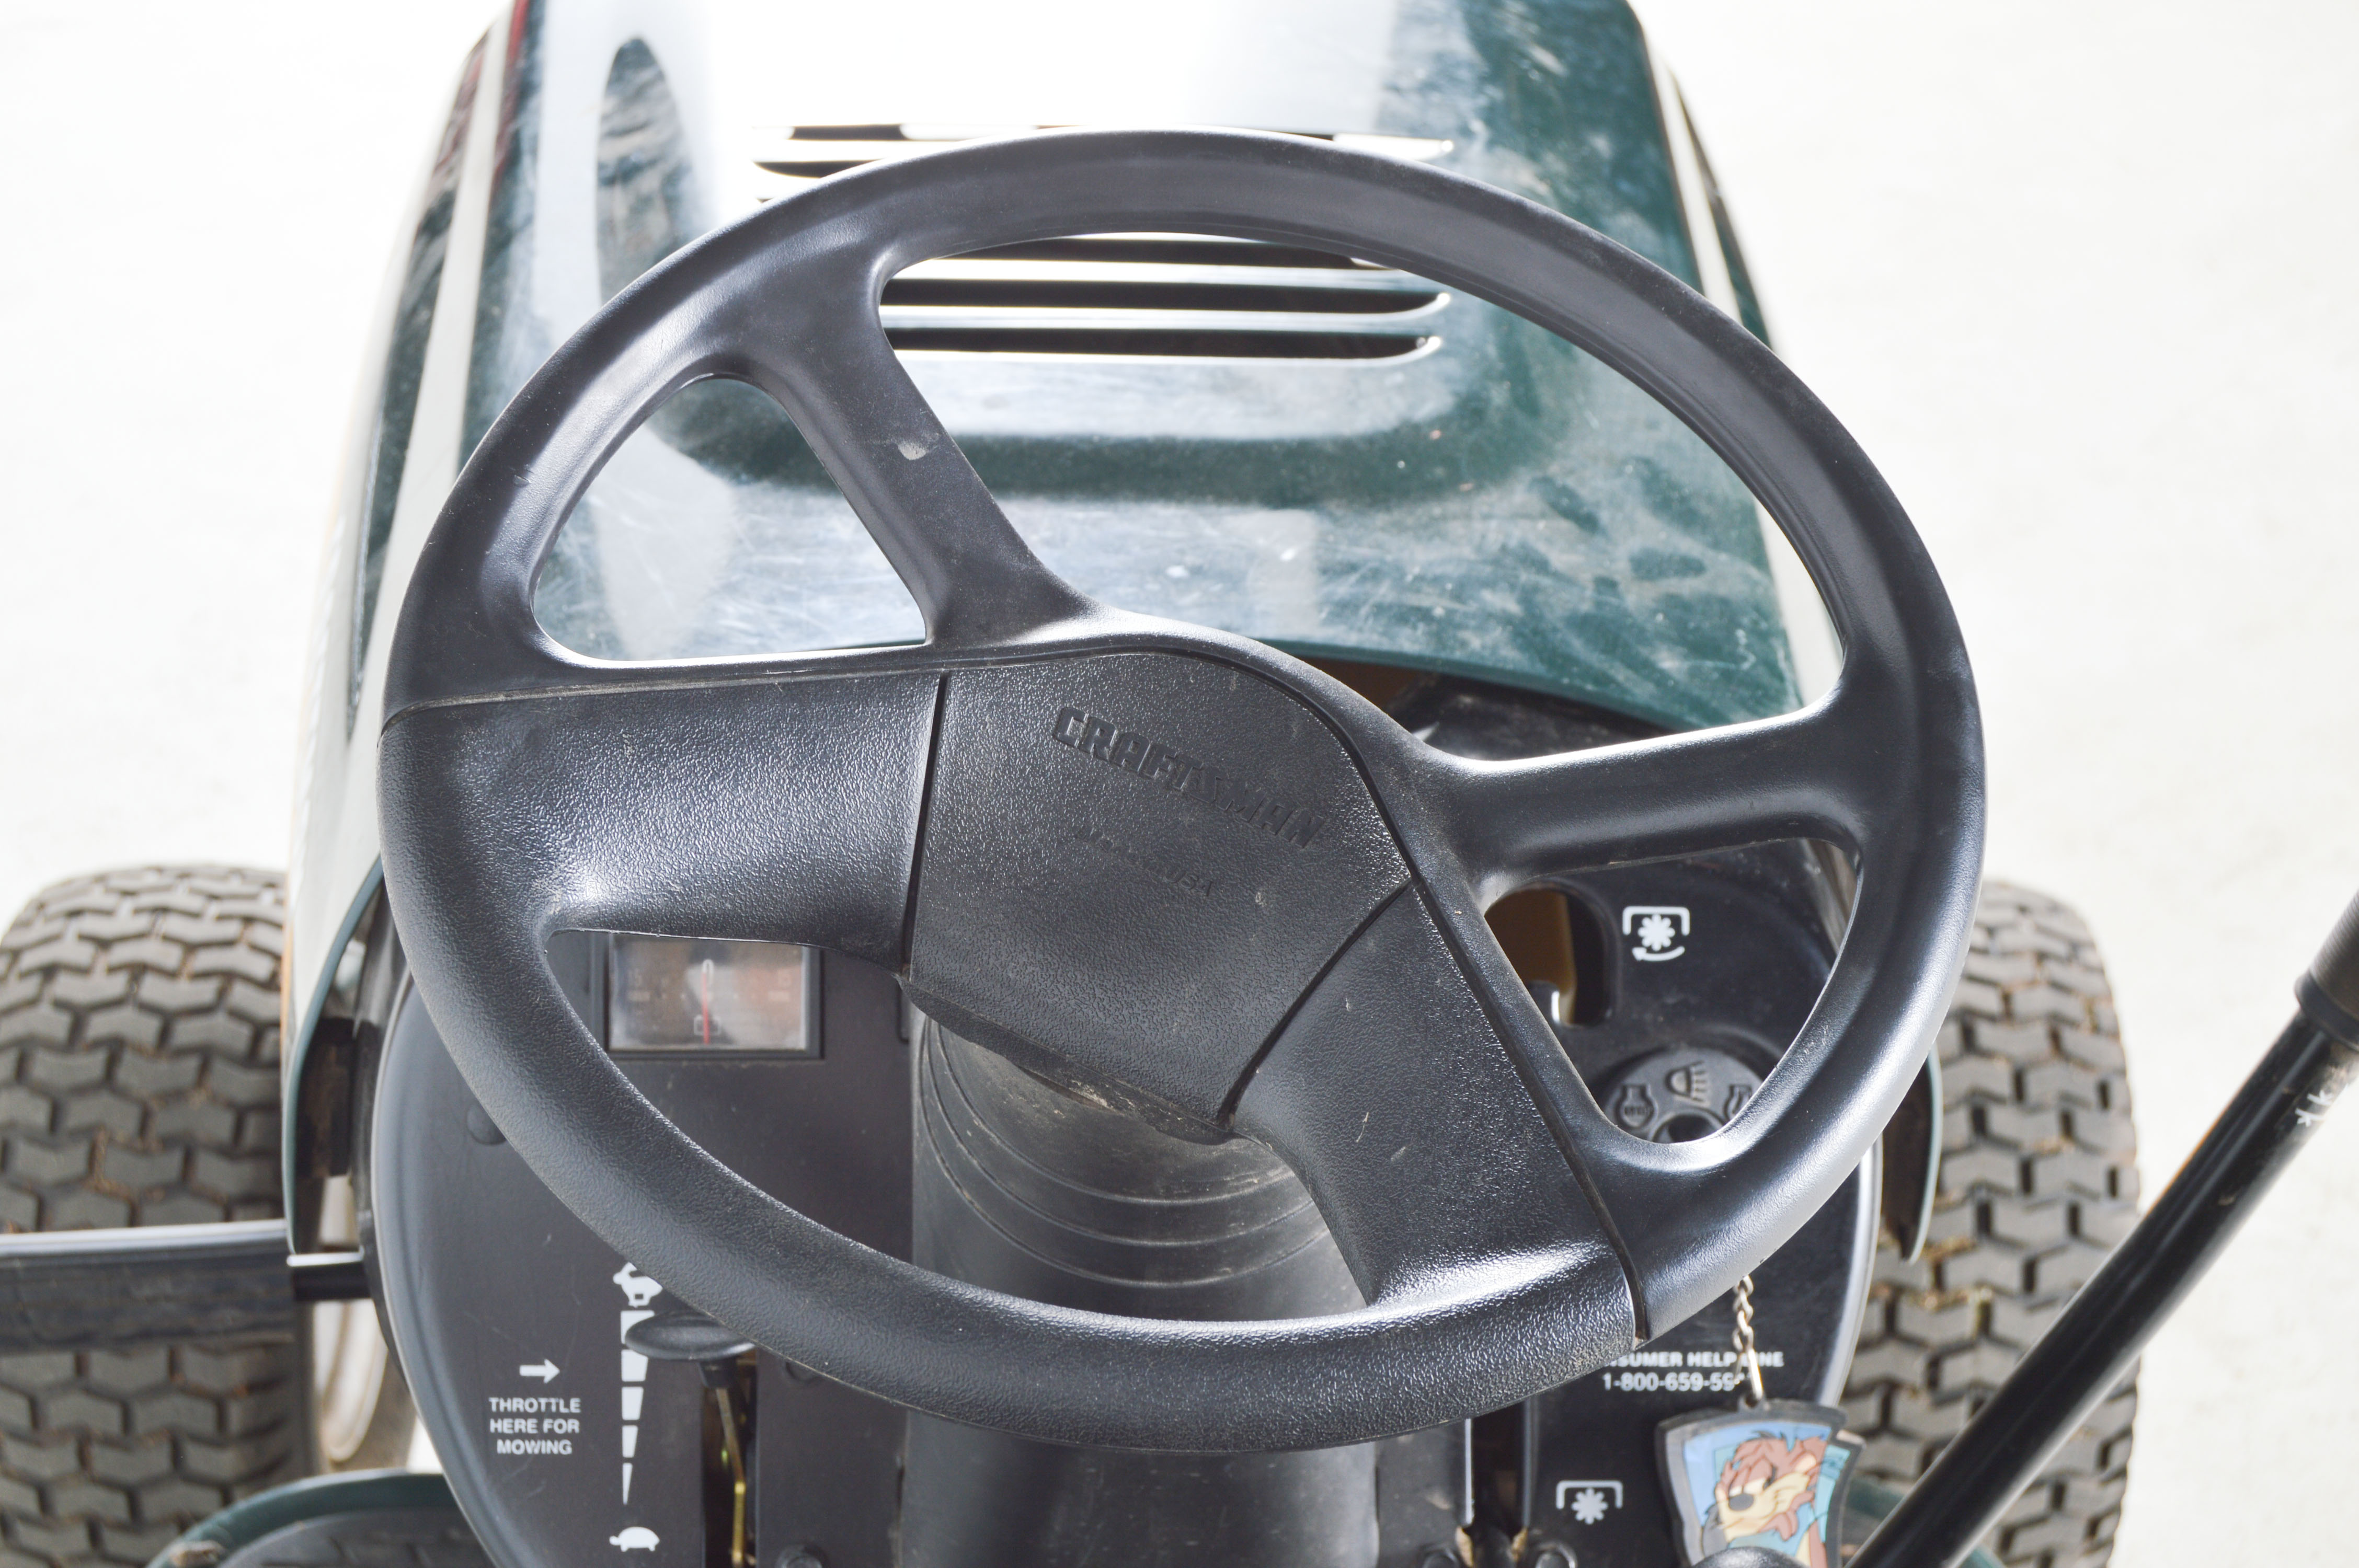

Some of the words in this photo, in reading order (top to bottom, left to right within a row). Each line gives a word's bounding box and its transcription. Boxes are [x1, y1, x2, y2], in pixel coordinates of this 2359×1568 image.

[1053, 706, 1324, 849] CRAFTSMAN
[1609, 1351, 1683, 1367] SUMER
[1687, 1351, 1737, 1367] HELP
[1741, 1351, 1784, 1367] LNE
[1602, 1371, 1751, 1391] 1-800-659-59
[489, 1397, 581, 1413] THROTTLE
[489, 1418, 539, 1434] HERE
[543, 1418, 580, 1434] FOR
[497, 1439, 572, 1455] MOWING
